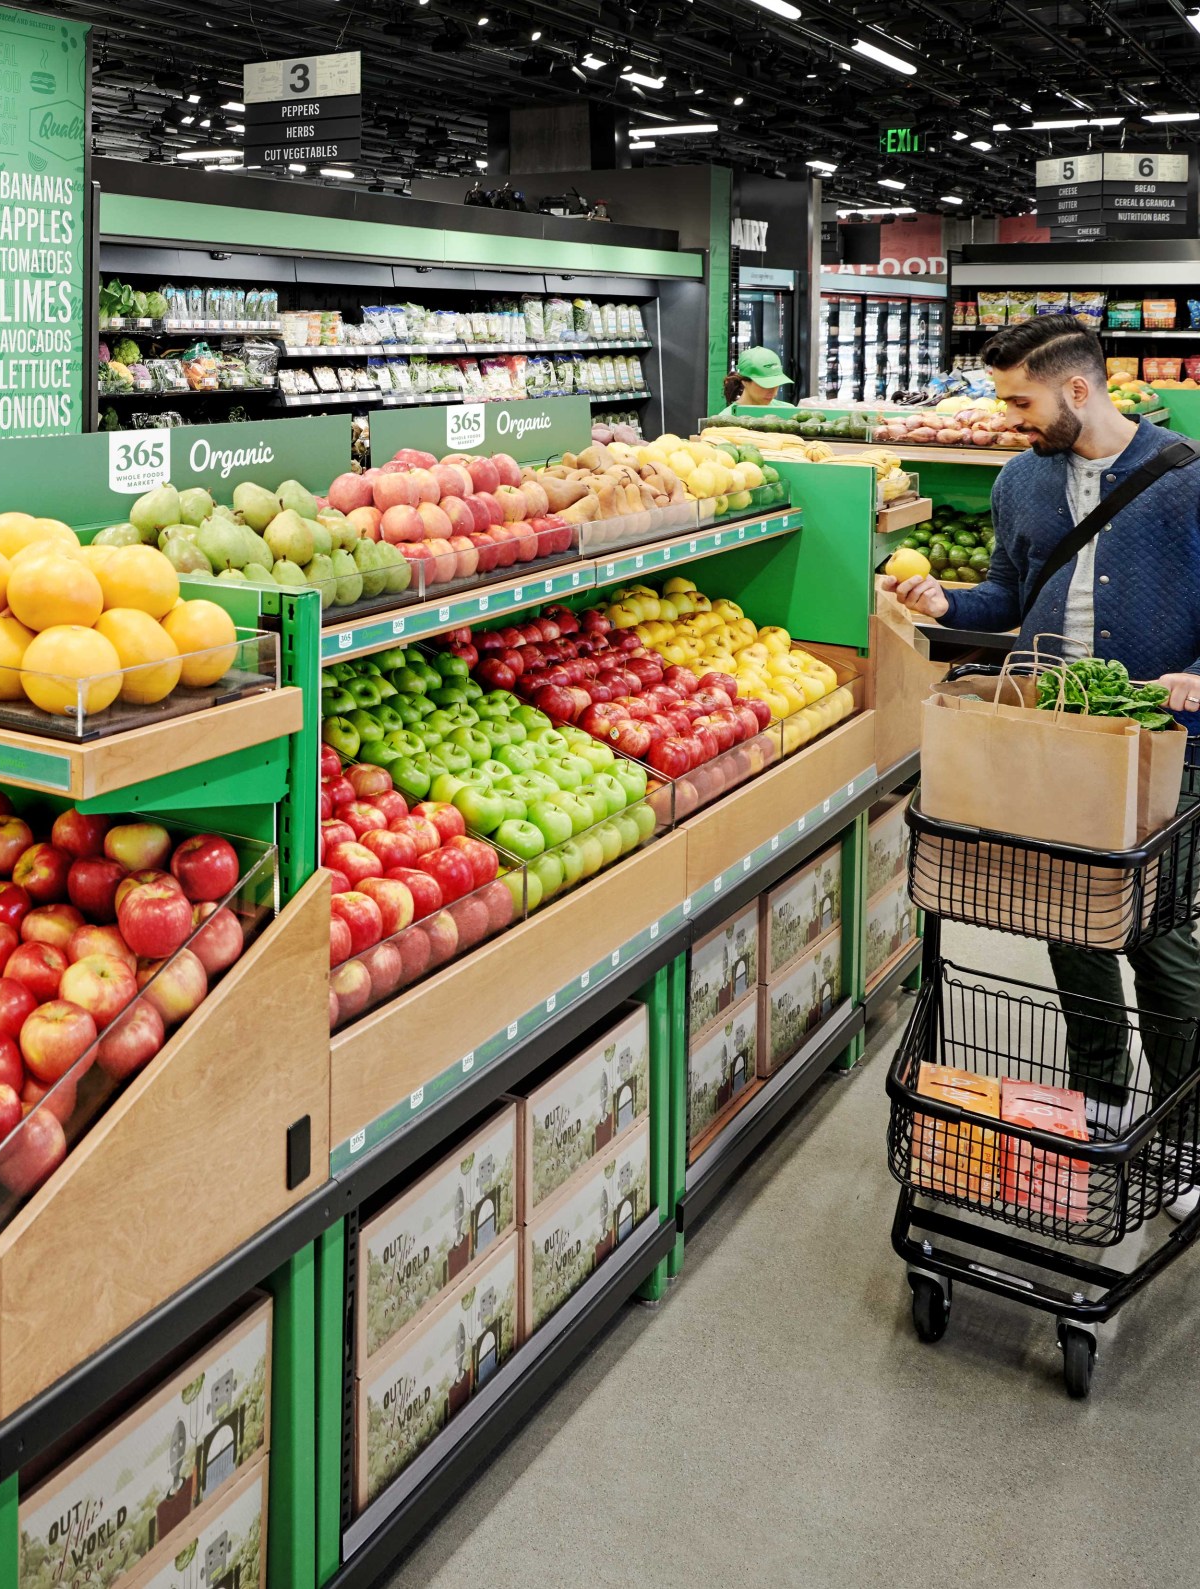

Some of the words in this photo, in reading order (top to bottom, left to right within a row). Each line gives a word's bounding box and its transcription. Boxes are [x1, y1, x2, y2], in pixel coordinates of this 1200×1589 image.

[289, 63, 310, 93] 3
[281, 103, 320, 117] PEPPERS
[39, 111, 85, 141] Quali
[286, 125, 315, 138] HERBS
[264, 149, 282, 161] CUT
[283, 145, 338, 159] VEGETABLES
[1139, 157, 1154, 177] 6
[1063, 161, 1074, 180] 5
[0, 171, 73, 205] BANANAS
[1058, 187, 1078, 196] CHEESE
[1114, 199, 1138, 207] CEREAL
[1145, 199, 1175, 207] GRANOLA
[1134, 184, 1156, 193] BREAD
[1057, 214, 1078, 223] YOGURT
[1058, 201, 1078, 210] BUTTER
[1118, 213, 1152, 221] NUTRITION
[1153, 213, 1170, 222] BARS
[0, 206, 73, 244] APPLES
[731, 218, 768, 251] AIRY
[0, 247, 73, 274] TOMATOES
[0, 279, 72, 323] LIMES
[0, 329, 72, 353] AVOCADOS
[0, 359, 71, 389] LETTUCE
[0, 394, 71, 430] ONIONS
[451, 412, 481, 434] 365
[497, 411, 552, 440] Organic
[116, 440, 164, 471] 365
[190, 439, 274, 478] Organic
[545, 1105, 560, 1129] OUT
[351, 1133, 364, 1146] 365
[556, 1118, 581, 1149] WORLD
[383, 1233, 403, 1264] OUT
[544, 1228, 560, 1254] OUT
[555, 1239, 581, 1273] WORLD
[397, 1245, 430, 1286] WORLD
[383, 1377, 403, 1410] OUT
[397, 1385, 431, 1428] WORLD
[48, 1501, 82, 1545] OUT
[71, 1505, 127, 1567] WORLD
[71, 1537, 125, 1589] ODUCE
